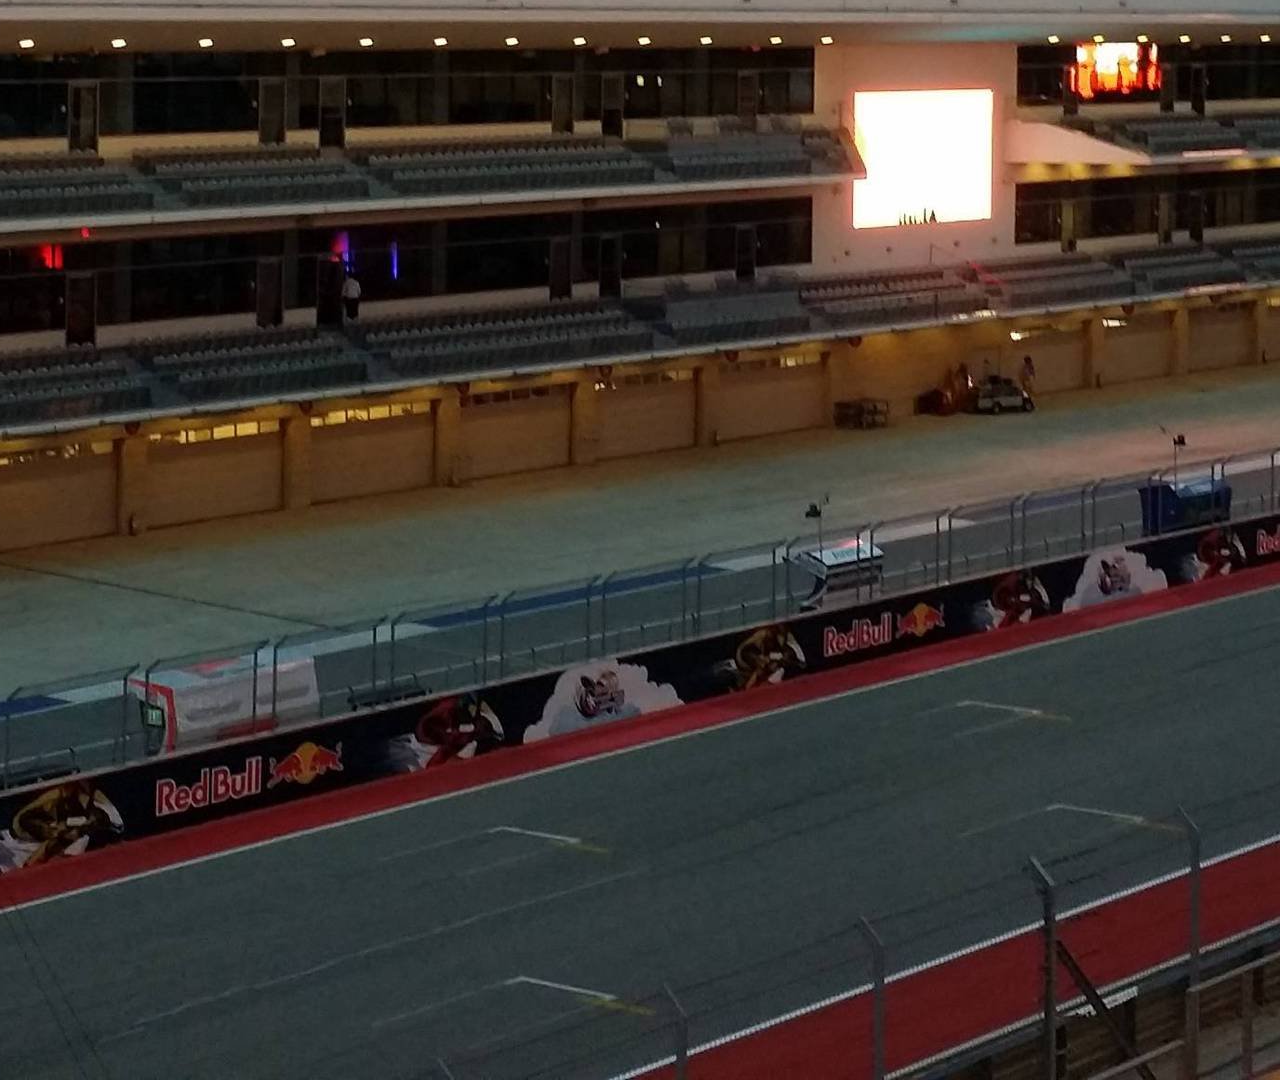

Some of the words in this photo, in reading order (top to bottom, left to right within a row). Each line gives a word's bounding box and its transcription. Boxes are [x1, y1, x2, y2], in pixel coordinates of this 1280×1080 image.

[824, 619, 858, 657] Red
[859, 612, 892, 648] Bull
[156, 768, 210, 817] Red
[211, 756, 262, 804] Bull
